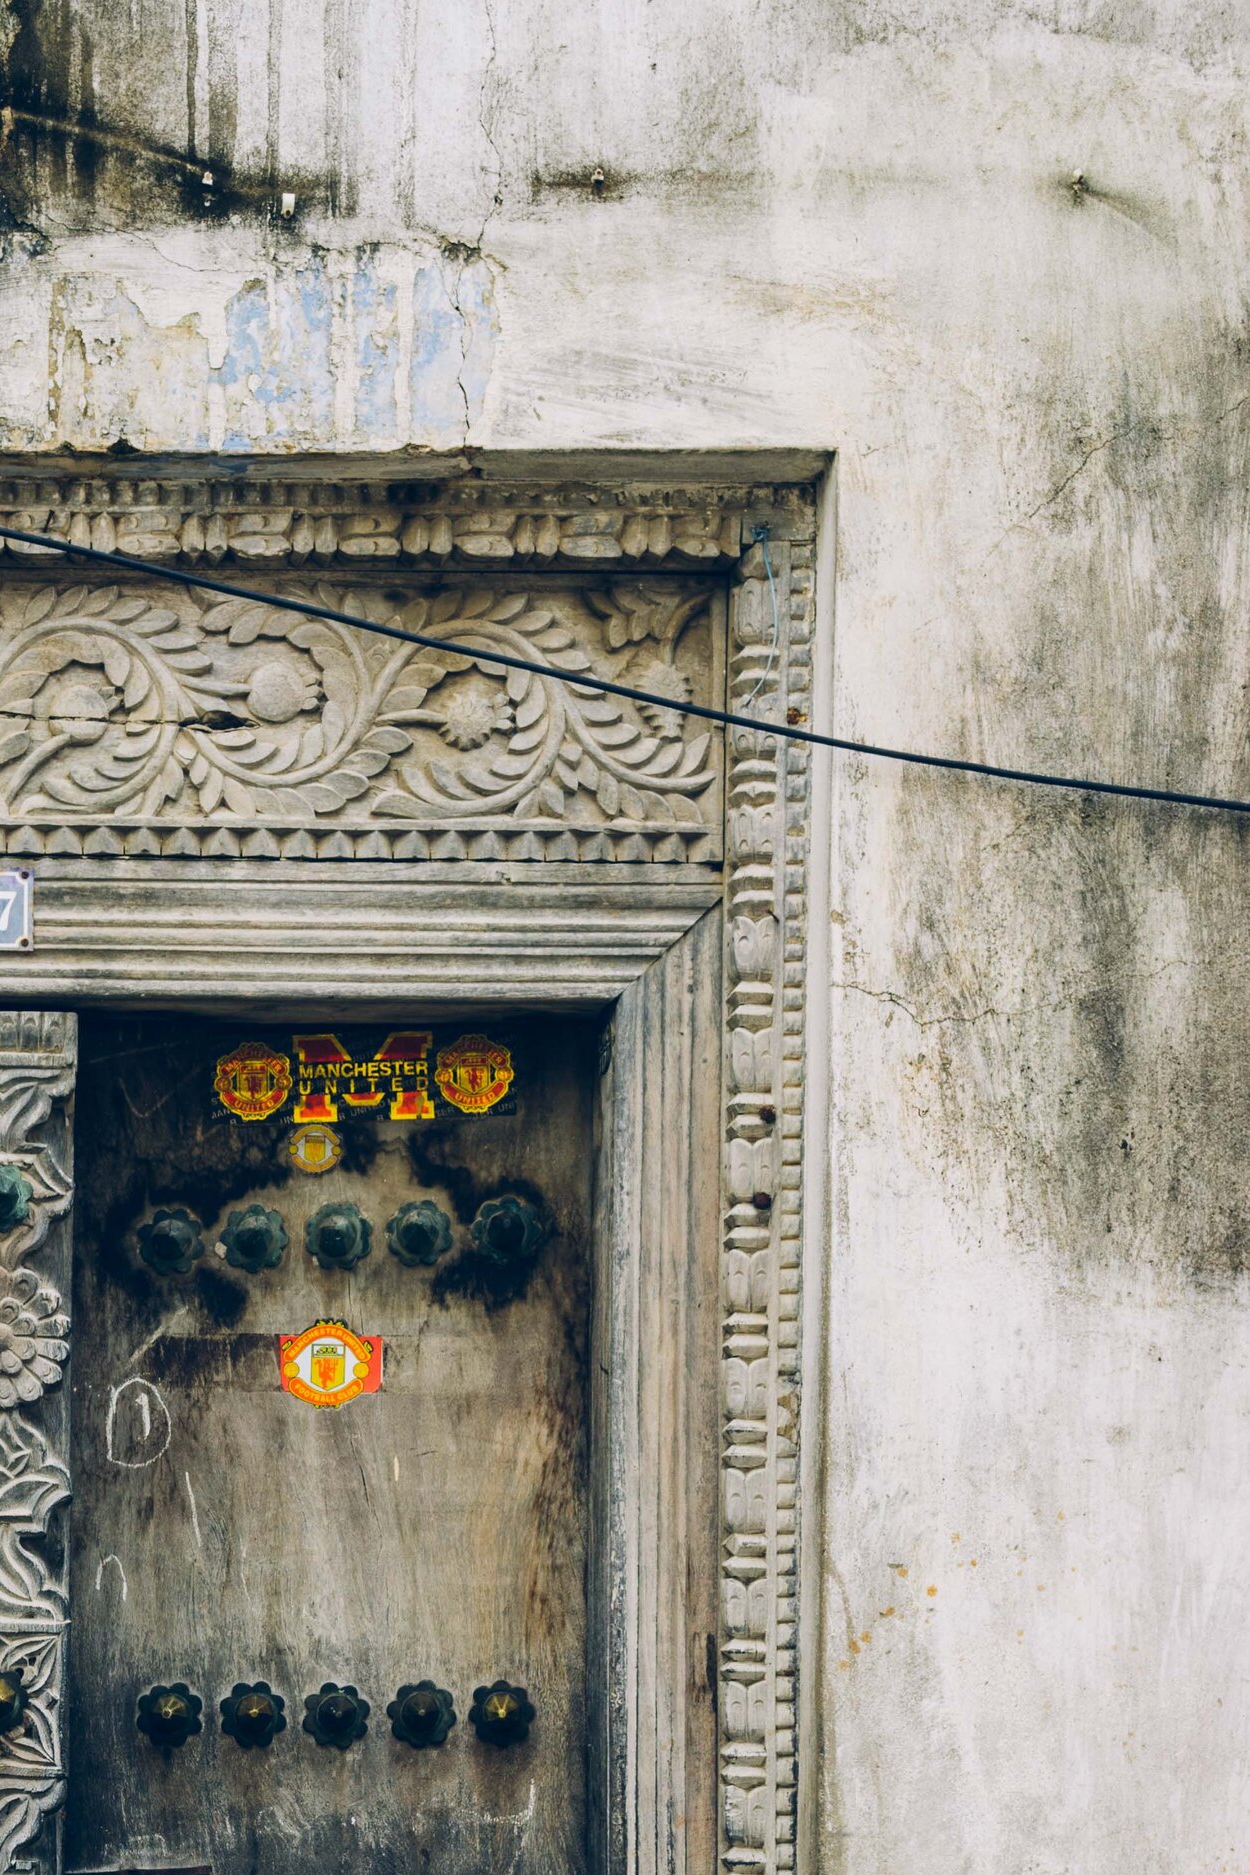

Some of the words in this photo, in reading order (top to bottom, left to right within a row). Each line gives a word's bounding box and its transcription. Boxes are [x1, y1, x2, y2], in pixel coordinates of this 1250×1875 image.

[299, 1061, 429, 1079] MANCHESTER
[299, 1076, 429, 1095] UNITED
[234, 1099, 275, 1113] UNITED
[454, 1092, 496, 1106] UNITED
[288, 1327, 343, 1357] MANCHESTER
[343, 1332, 365, 1359] UNITED
[295, 1383, 335, 1403] FOOTBALL
[337, 1385, 359, 1400] CLUB
